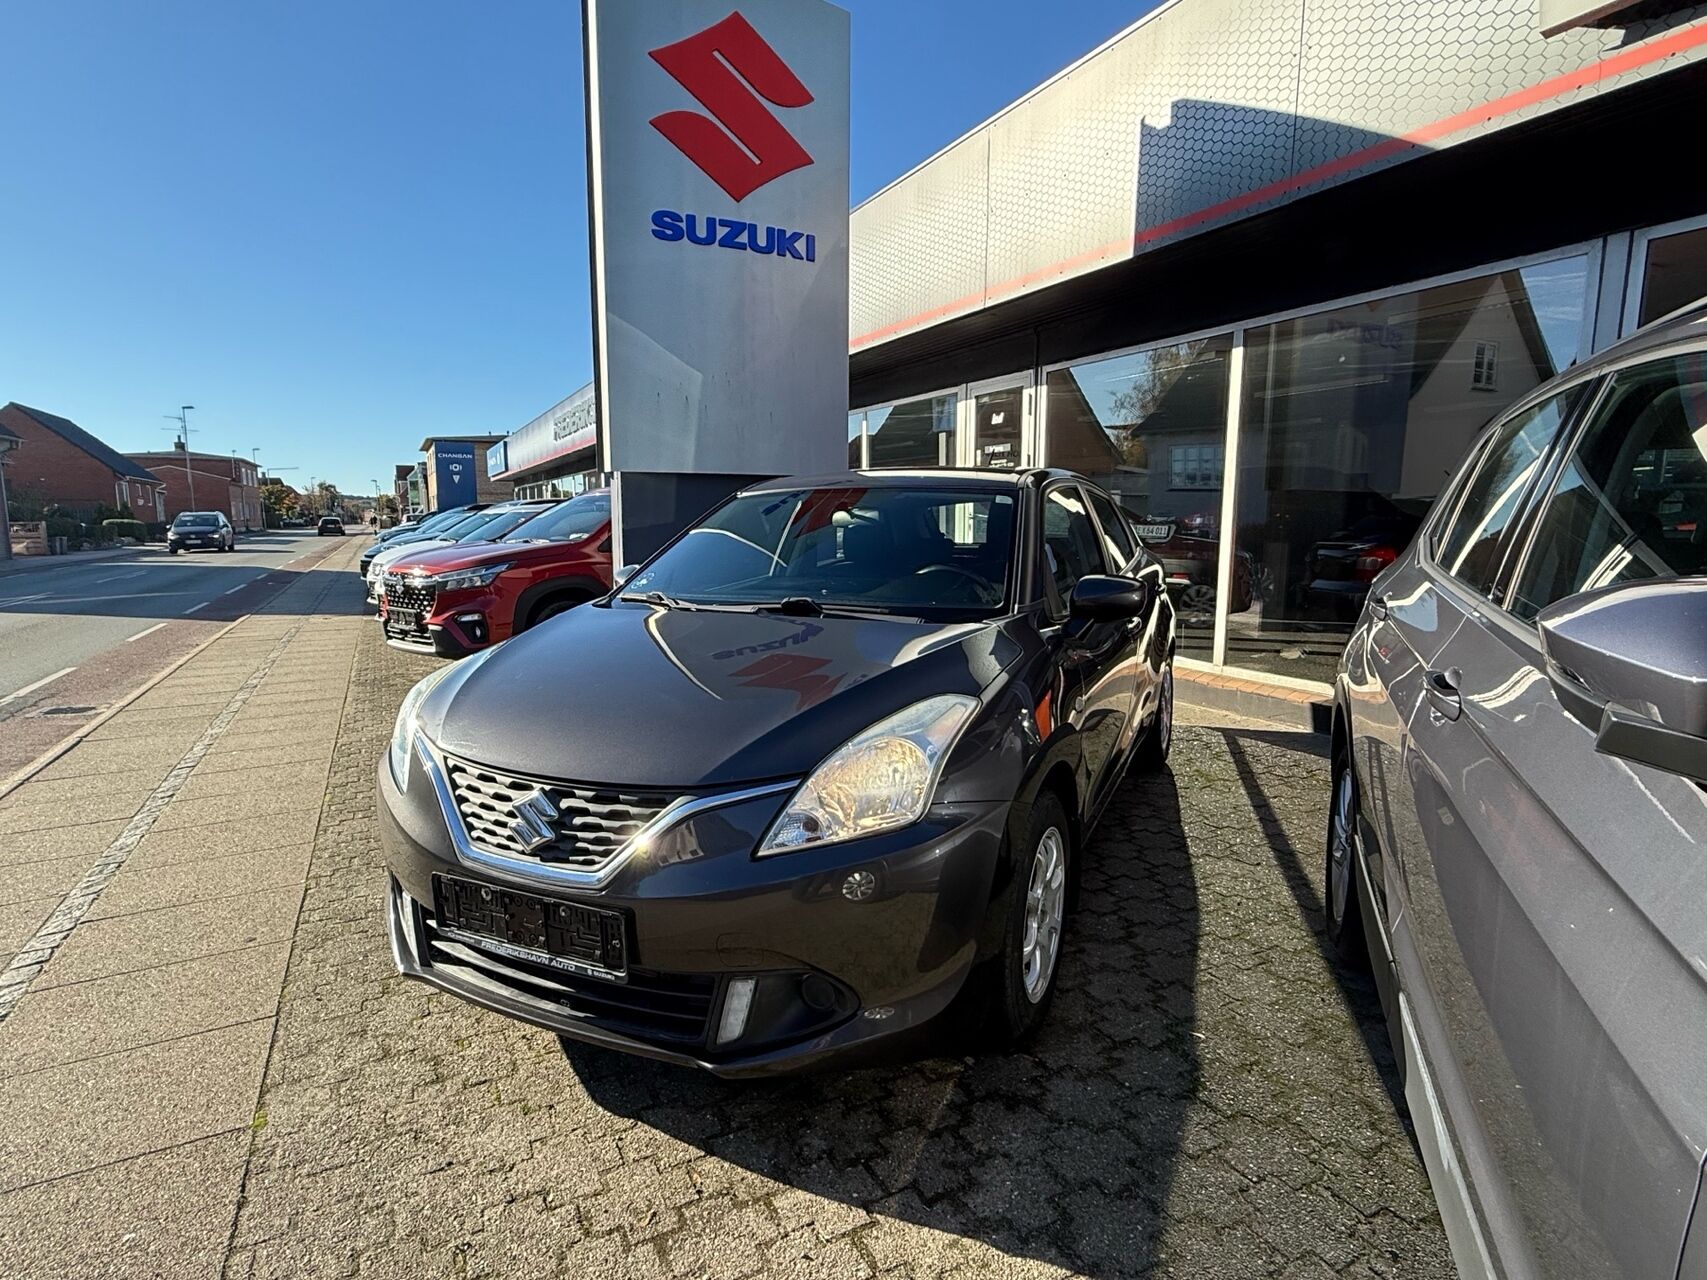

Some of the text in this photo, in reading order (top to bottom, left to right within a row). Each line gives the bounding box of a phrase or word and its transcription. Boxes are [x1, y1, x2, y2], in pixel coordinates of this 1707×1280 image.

[651, 210, 816, 262] SUZUKI
[481, 941, 575, 971] FREDERIKSHAVN AUTO
